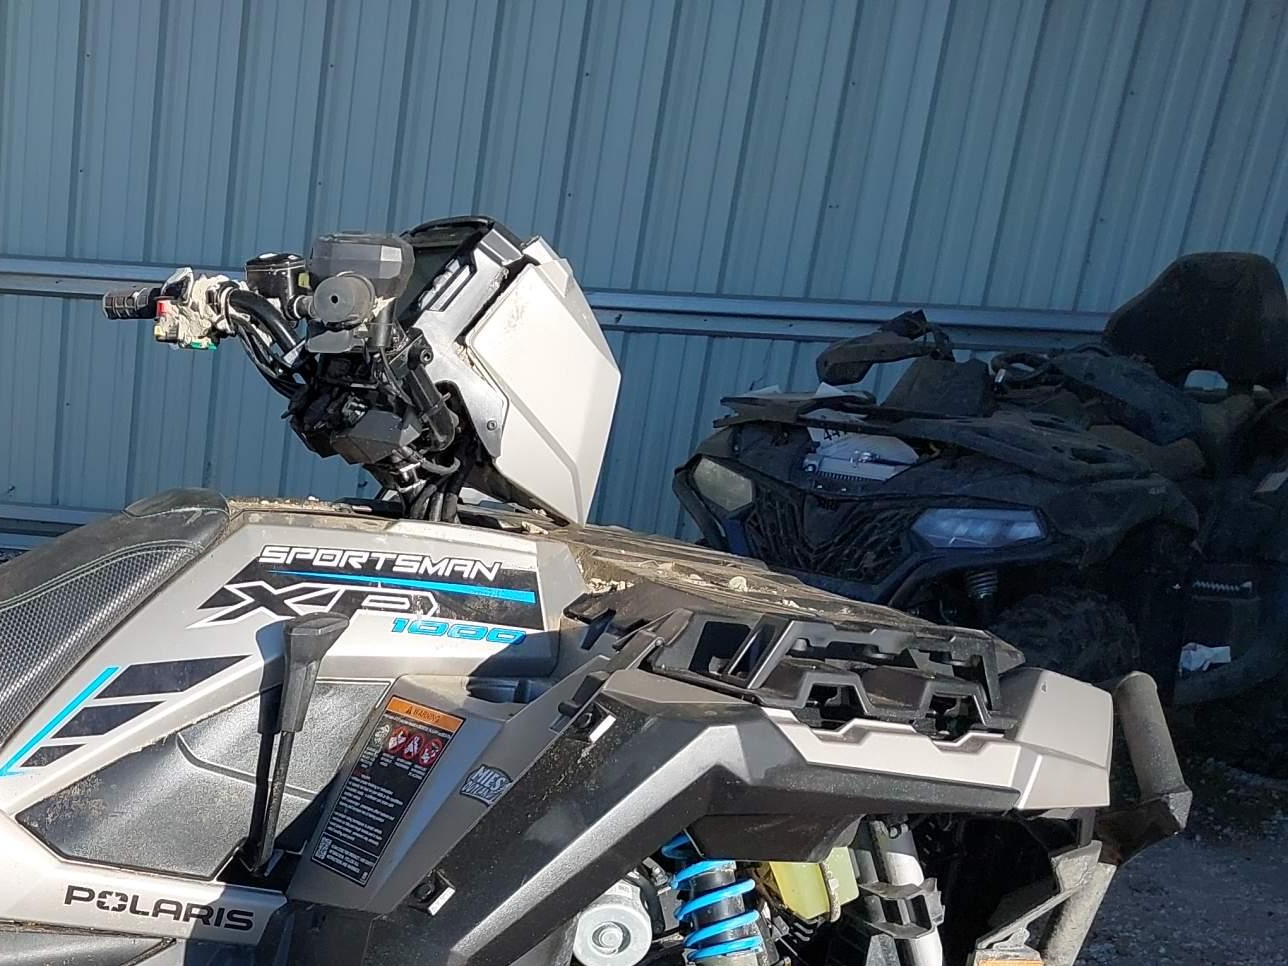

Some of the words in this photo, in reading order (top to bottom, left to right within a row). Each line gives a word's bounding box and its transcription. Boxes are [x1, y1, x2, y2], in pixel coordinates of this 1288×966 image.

[258, 545, 501, 582] SPORTSMAN
[185, 581, 439, 629] XP
[391, 617, 528, 646] 1000
[64, 884, 255, 931] POLARIS
